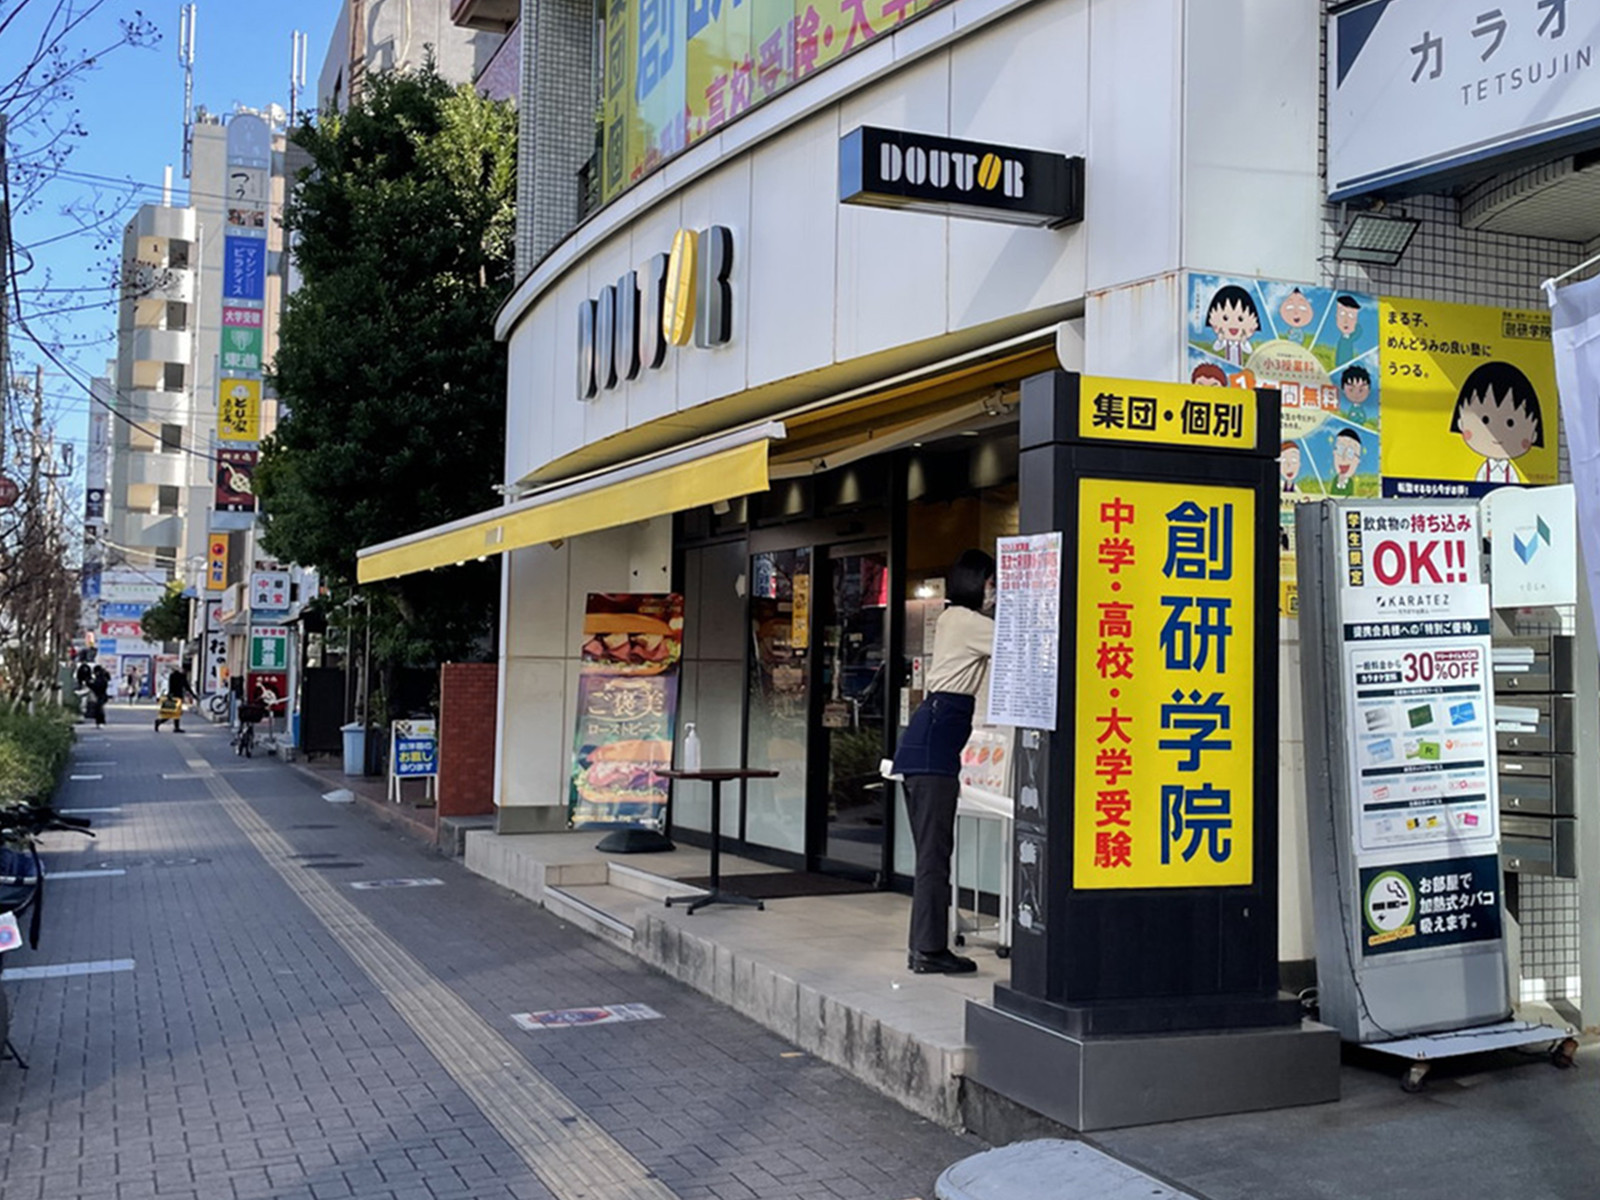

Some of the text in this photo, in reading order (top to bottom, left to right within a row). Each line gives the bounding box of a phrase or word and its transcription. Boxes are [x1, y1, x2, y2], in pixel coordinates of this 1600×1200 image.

[1461, 45, 1592, 106] TETSUJIN
[880, 141, 1026, 199] DOUTOR
[1387, 311, 1429, 328] まる子、
[1386, 336, 1492, 358] めんどうみの良い塾に
[1387, 362, 1430, 379] うつる。
[1092, 391, 1244, 440] 集団・個別
[1362, 513, 1472, 534] 飲食物の持ち込み
[1347, 511, 1364, 587] 学生限定
[1372, 539, 1468, 587] OK!!
[1388, 594, 1450, 607] KARATEZ
[1094, 496, 1136, 869] 中学・高校・大学受験
[1157, 500, 1235, 867] 創研学院
[1418, 872, 1473, 894] お部屋で
[1418, 890, 1495, 916] 加熱式タバコ
[1419, 913, 1478, 935] 吸えます。
